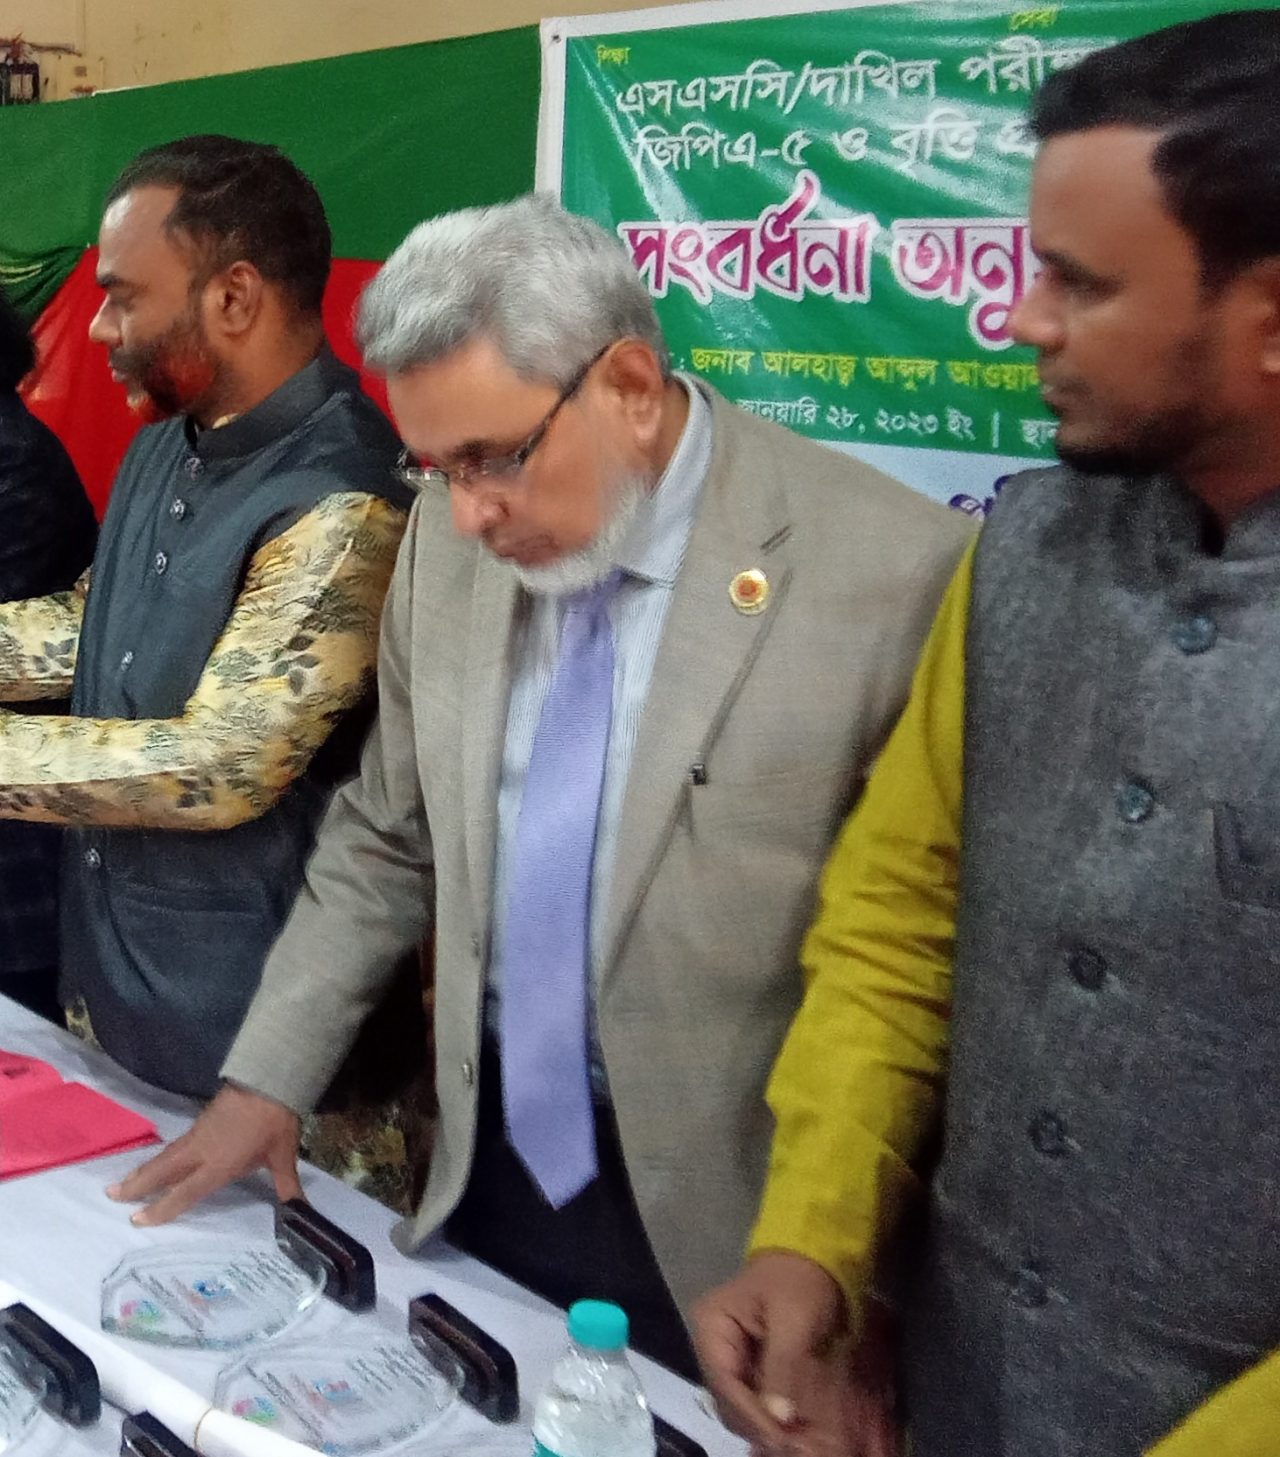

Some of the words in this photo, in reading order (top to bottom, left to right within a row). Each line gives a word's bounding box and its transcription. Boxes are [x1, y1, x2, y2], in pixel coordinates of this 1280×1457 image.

[616, 50, 941, 117] এসএসসি/দাখিল
[633, 121, 812, 170] জিপিএ-৫
[833, 127, 868, 161] ও
[888, 107, 982, 178] বৃত্তি
[620, 171, 876, 301] সংবর্ধনা
[893, 219, 1034, 348] অনু
[691, 349, 756, 375] জনাব
[875, 408, 940, 436] ২০২৩
